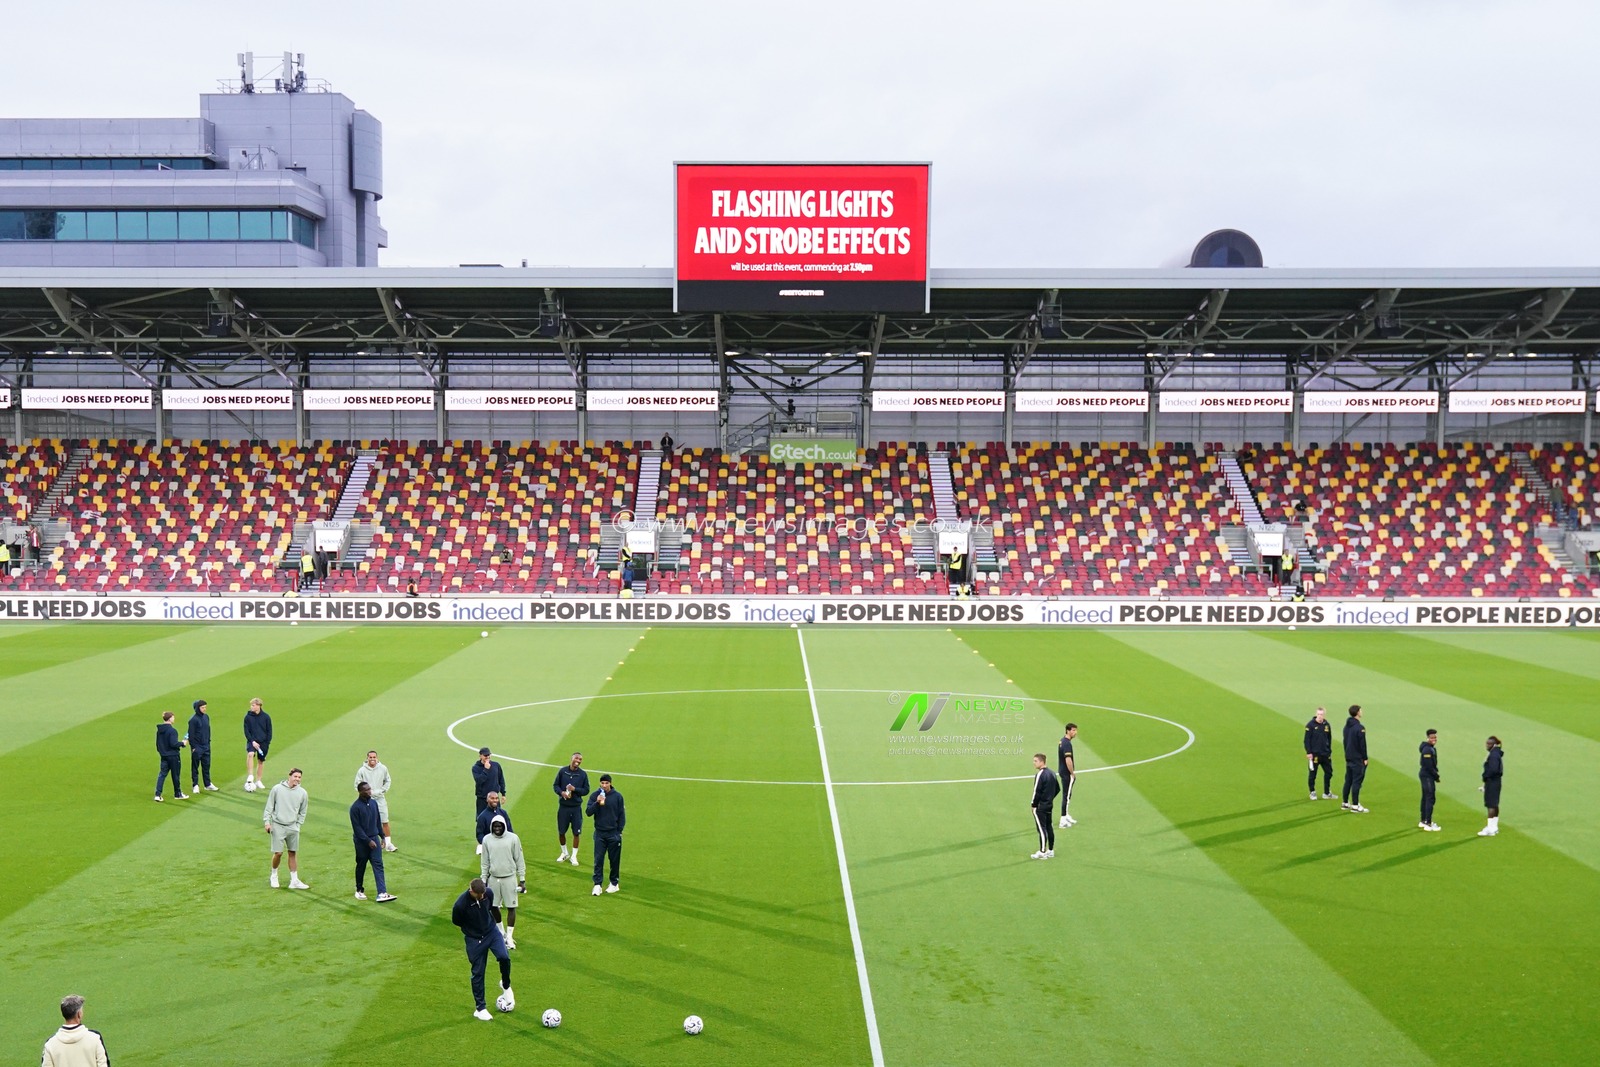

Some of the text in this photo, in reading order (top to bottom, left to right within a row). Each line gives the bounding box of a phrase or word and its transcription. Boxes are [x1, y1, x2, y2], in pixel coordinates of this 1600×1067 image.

[712, 190, 894, 217] FLASHING LIGHTS
[694, 227, 911, 254] AND STROBE EFFECTS
[731, 263, 741, 271] will
[742, 263, 750, 271] be
[751, 263, 765, 271] used
[766, 263, 772, 271] at
[773, 263, 784, 271] this
[785, 263, 803, 272] event,
[804, 263, 842, 273] commencing
[843, 263, 849, 271] at
[27, 394, 149, 403] indeed JOBS NEED PEOPLE
[168, 395, 290, 404] indeed JOBS NEED PEOPLE
[309, 395, 431, 404] indeed JOBS NEED PEOPLE
[450, 395, 573, 404] indeed JOBS NEED PEOPLE
[592, 396, 715, 405] indeed JOBS NEED PEOPLE
[878, 396, 1002, 405] indeed JOBS NEED PEOPLE
[1021, 397, 1146, 406] indeed JOBS NEED PEOPLE
[1165, 397, 1290, 406] indeed JOBS NEED PEOPLE
[1309, 397, 1435, 406] indeed JOBS NEED PEOPLE
[1454, 397, 1582, 406] indeed JOBS NEED PEOPLE
[770, 443, 856, 460] Gtech.co.uk
[33, 600, 89, 618] NEED
[91, 601, 146, 617] JOBS
[164, 601, 441, 619] indeed PEOPLE NEED JOBS
[453, 603, 730, 620] indeed PEOPLE NEED JOBS
[744, 604, 1024, 621] indeed PEOPLE NEED JOBS
[1042, 606, 1324, 622] indeed PEOPLE NEED JOBS
[1337, 607, 1408, 623] indeed
[1416, 607, 1499, 623] PEOPLE
[1504, 607, 1561, 623] NEED
